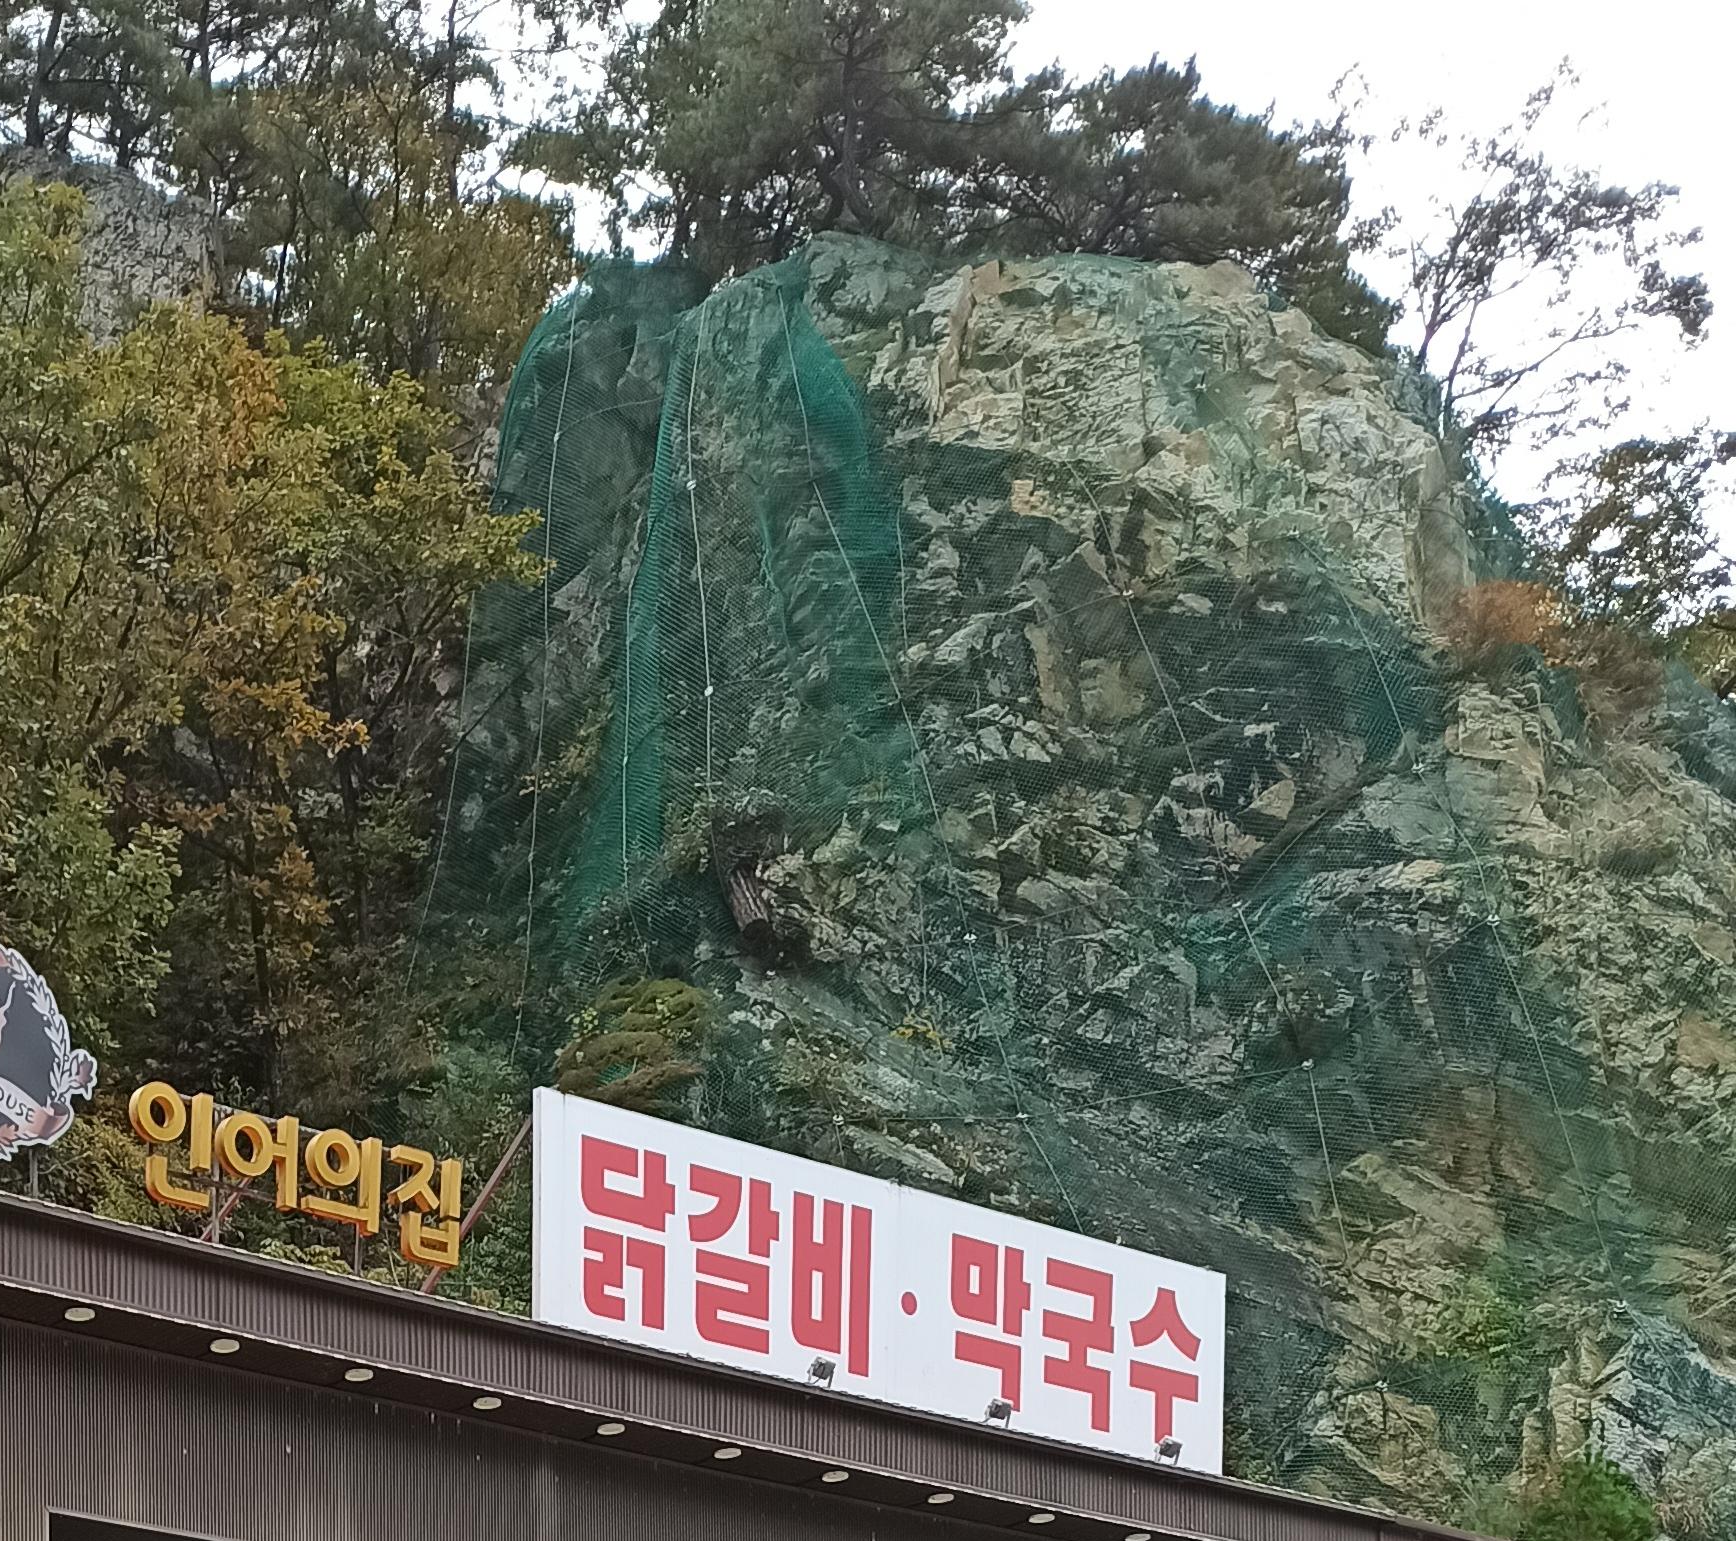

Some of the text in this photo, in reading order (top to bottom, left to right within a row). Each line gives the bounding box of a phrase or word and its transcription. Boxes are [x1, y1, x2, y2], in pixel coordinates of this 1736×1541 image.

[129, 1081, 461, 1269] 인어의집
[581, 1134, 873, 1377] 닭갈비
[950, 1233, 1202, 1445] 막국수
